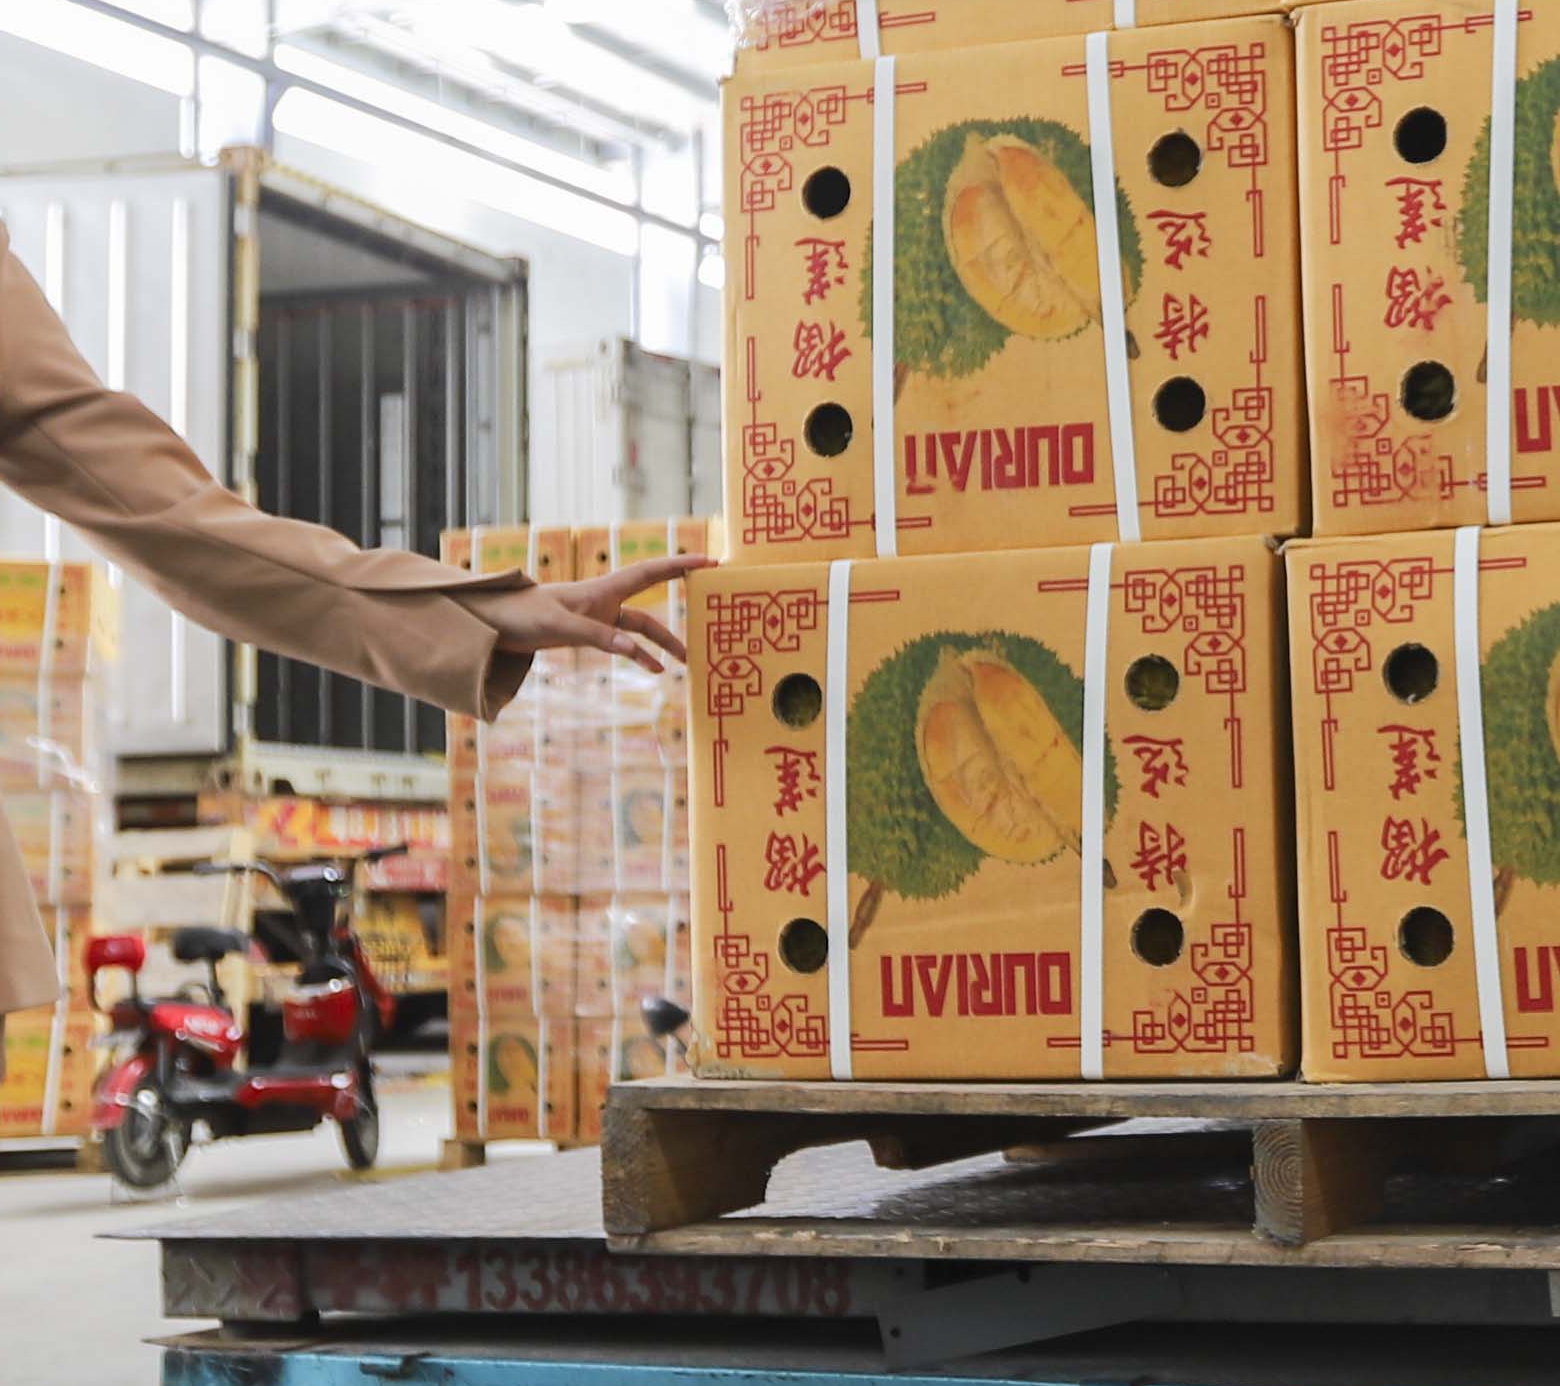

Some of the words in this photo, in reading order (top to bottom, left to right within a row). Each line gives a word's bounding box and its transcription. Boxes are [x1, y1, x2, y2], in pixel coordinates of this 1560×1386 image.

[792, 236, 850, 381] 榴莲
[1147, 210, 1211, 360] 特选
[1384, 177, 1453, 331] 榴莲
[905, 423, 1094, 495] DURIAN
[764, 745, 828, 896] 榴莲
[1122, 734, 1190, 892] 特选
[1376, 723, 1451, 884] 榴莲
[880, 951, 1072, 1018] DURIAN
